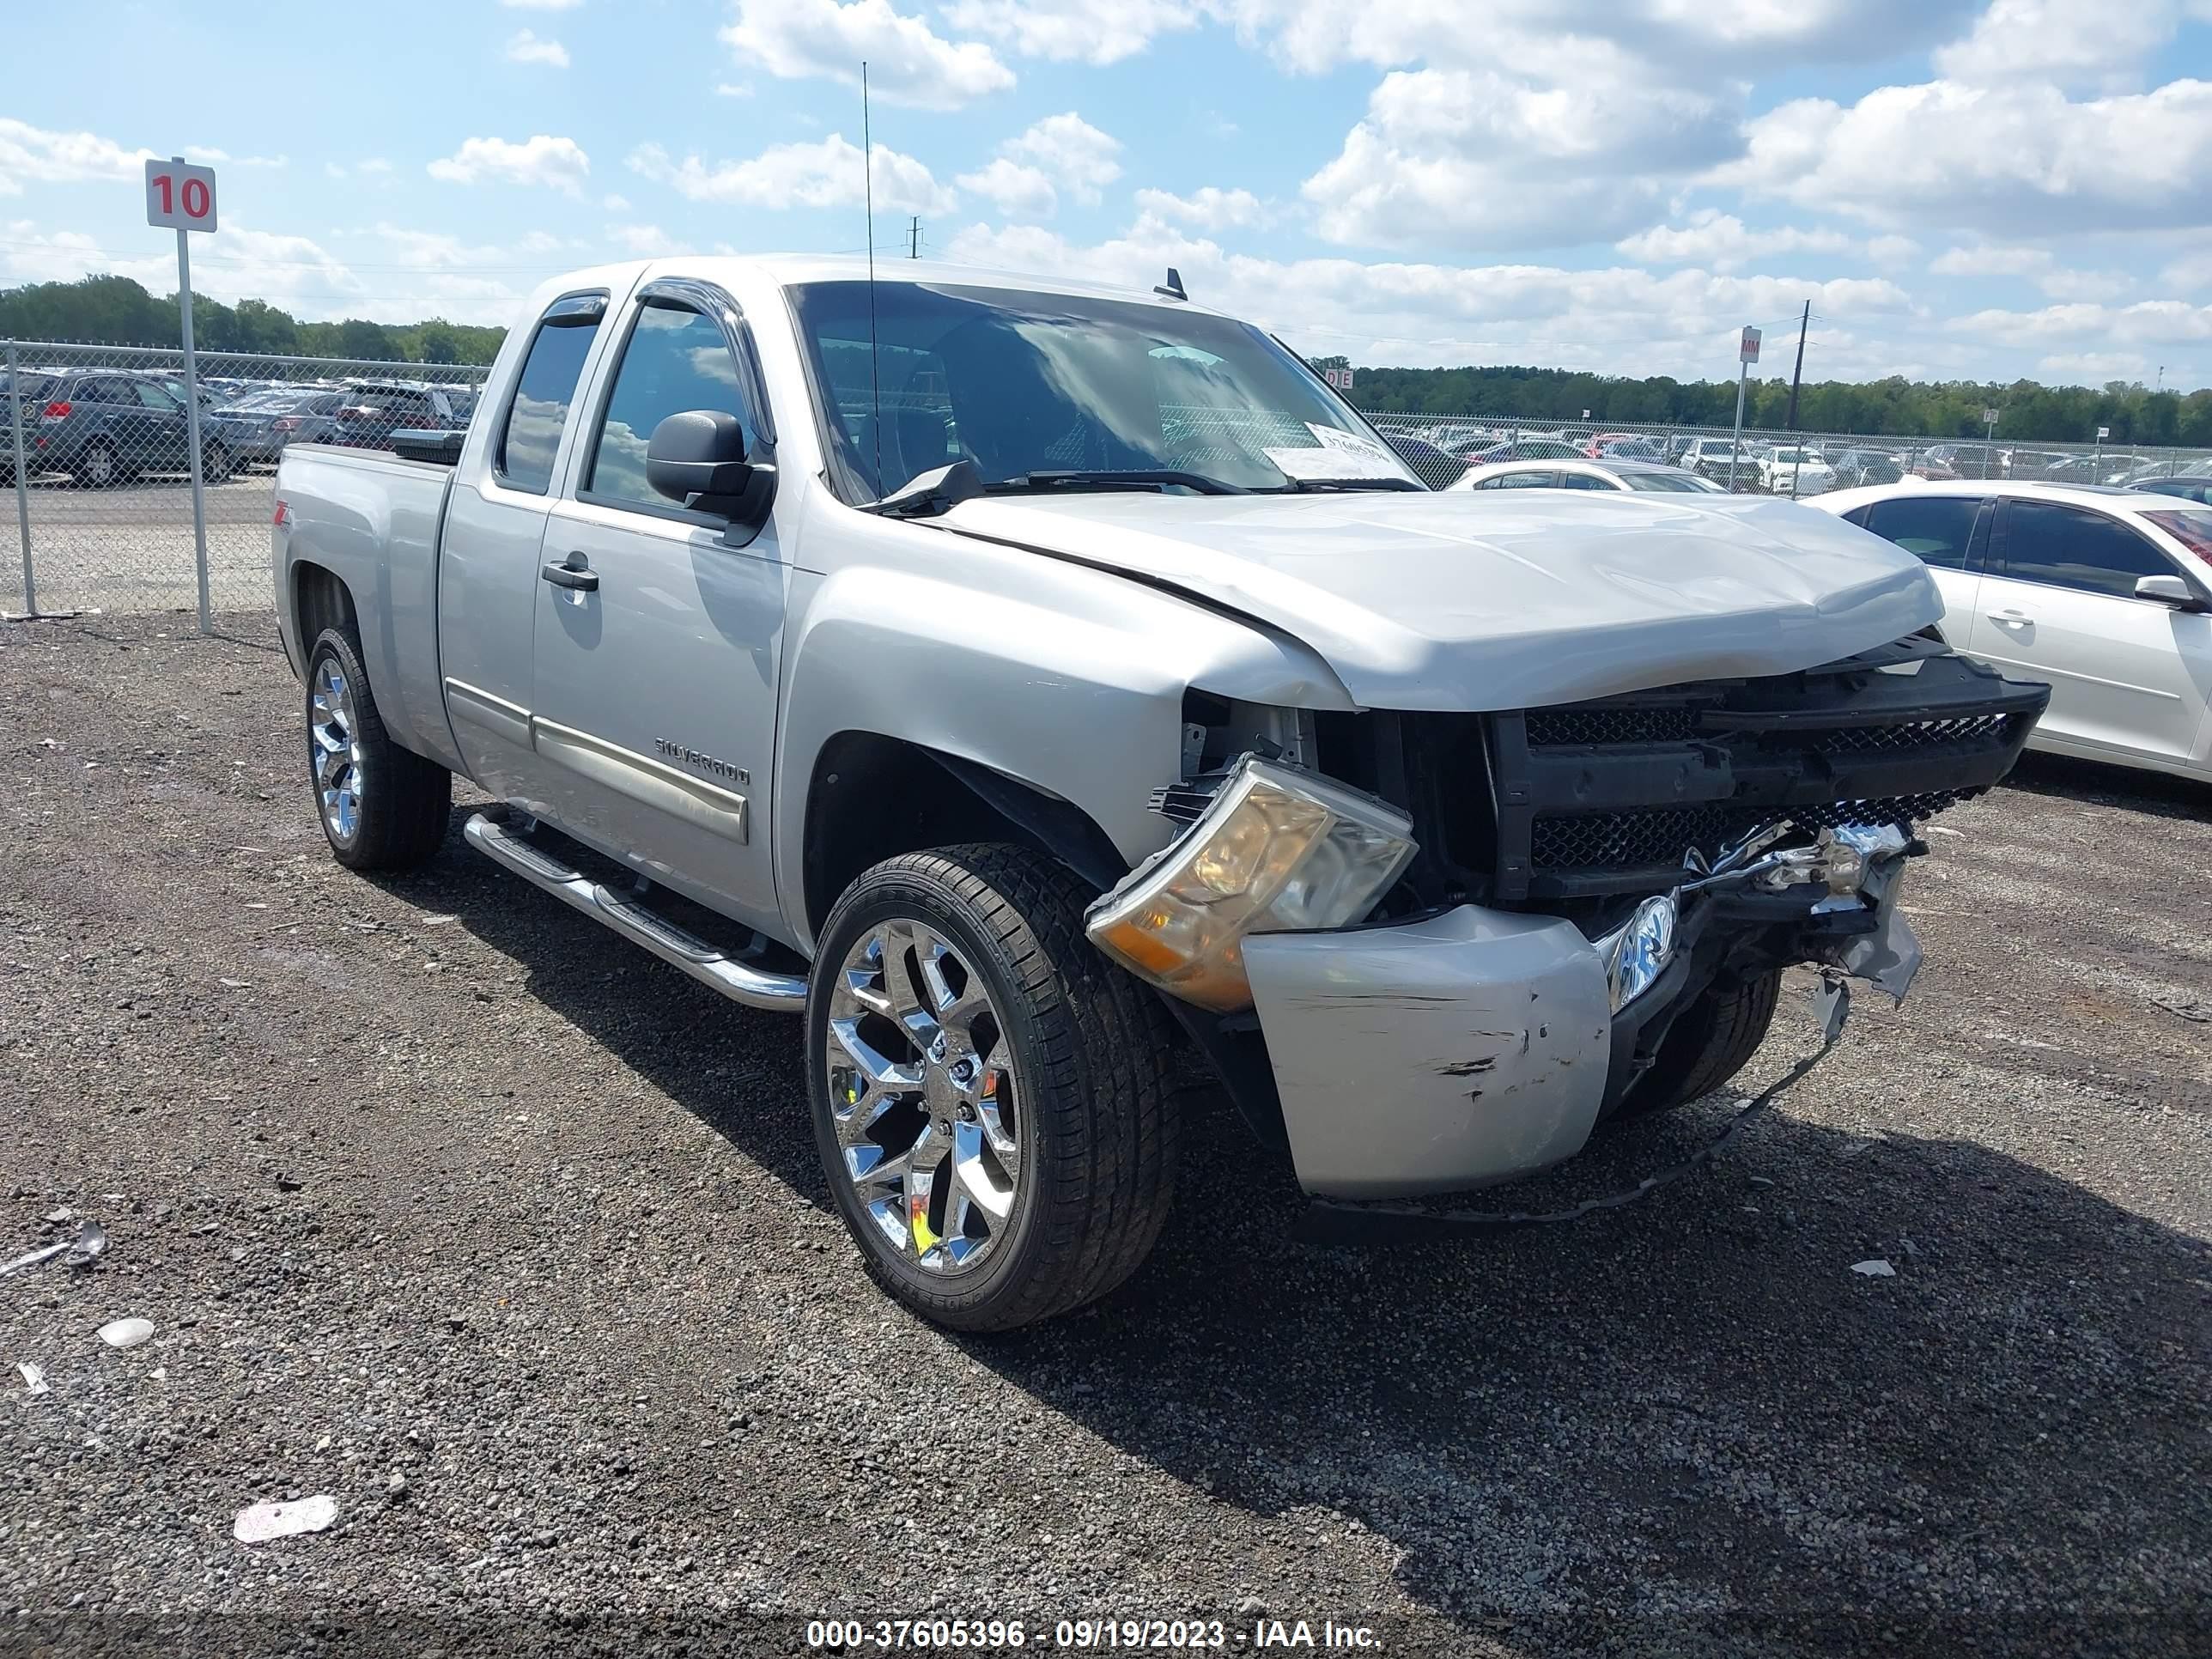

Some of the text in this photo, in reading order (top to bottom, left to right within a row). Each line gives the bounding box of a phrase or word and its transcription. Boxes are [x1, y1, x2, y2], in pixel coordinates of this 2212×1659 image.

[152, 175, 210, 218] 10
[1741, 338, 1759, 354] MM
[1328, 372, 1336, 385] D
[1343, 373, 1351, 386] E
[655, 737, 750, 786] SILVERADO
